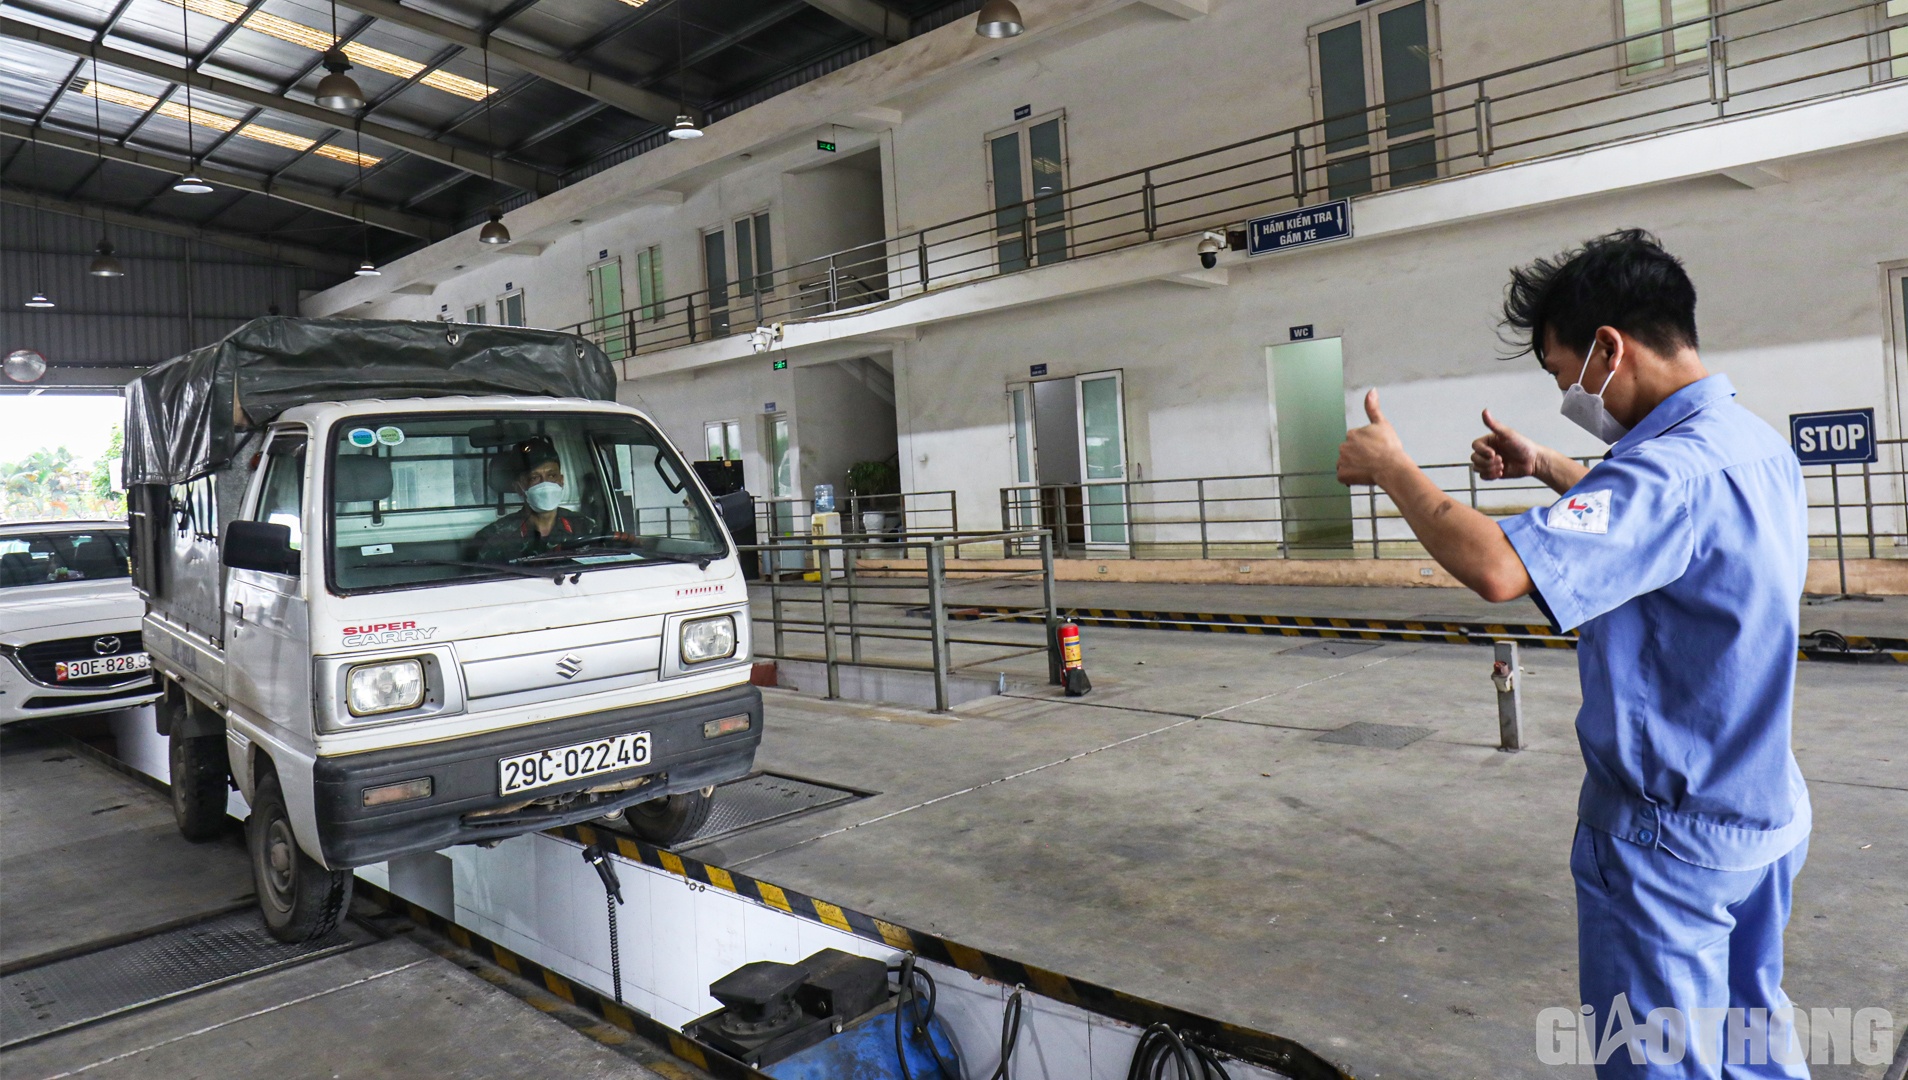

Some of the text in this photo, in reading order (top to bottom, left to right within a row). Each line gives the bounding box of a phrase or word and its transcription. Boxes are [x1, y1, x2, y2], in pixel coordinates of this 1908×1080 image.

[1286, 213, 1311, 230] KIỂM
[1313, 211, 1333, 224] TRA
[1304, 229, 1317, 240] XE
[1293, 328, 1309, 338] WC
[1799, 424, 1865, 453] STOP
[342, 621, 416, 635] SUPER
[342, 627, 437, 647] CARRY
[70, 654, 151, 677] 30E-828.9
[505, 736, 647, 791] 29C-022.46
